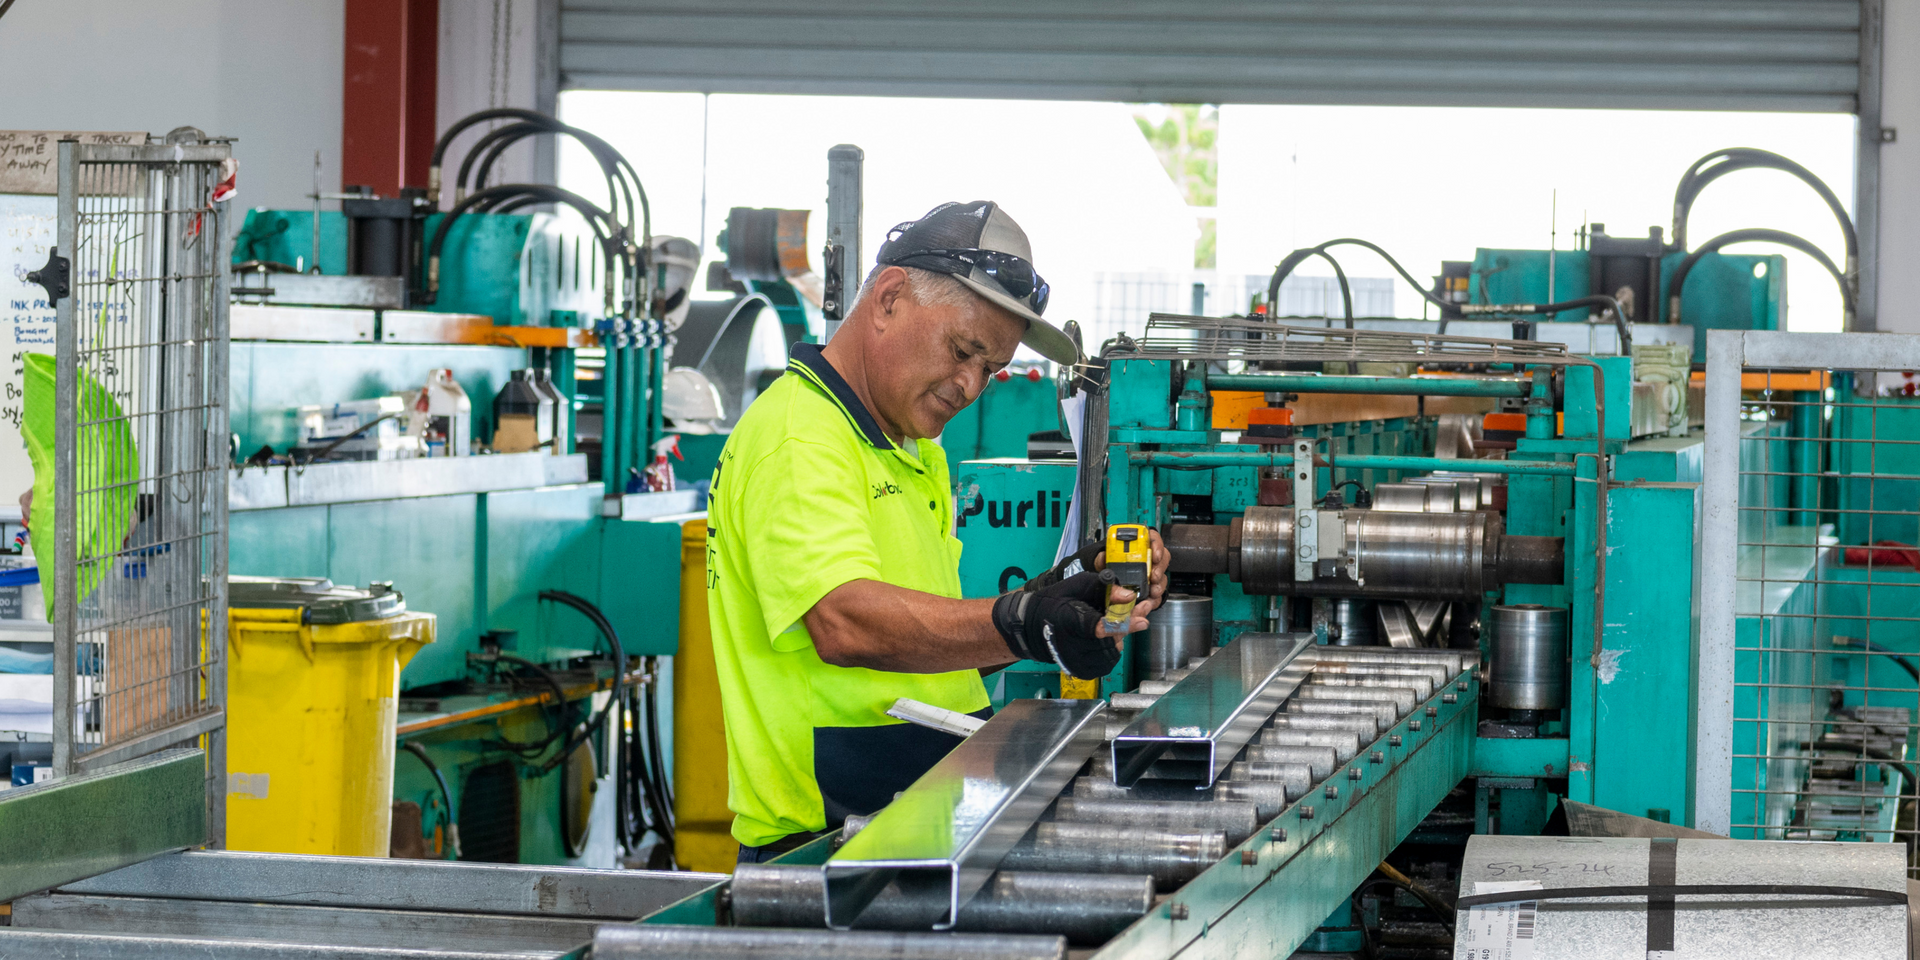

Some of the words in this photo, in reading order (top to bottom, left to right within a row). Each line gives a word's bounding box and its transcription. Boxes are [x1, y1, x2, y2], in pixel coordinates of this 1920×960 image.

[91, 134, 132, 144] TAKEN
[7, 158, 52, 175] AWAY
[10, 299, 30, 311] INK
